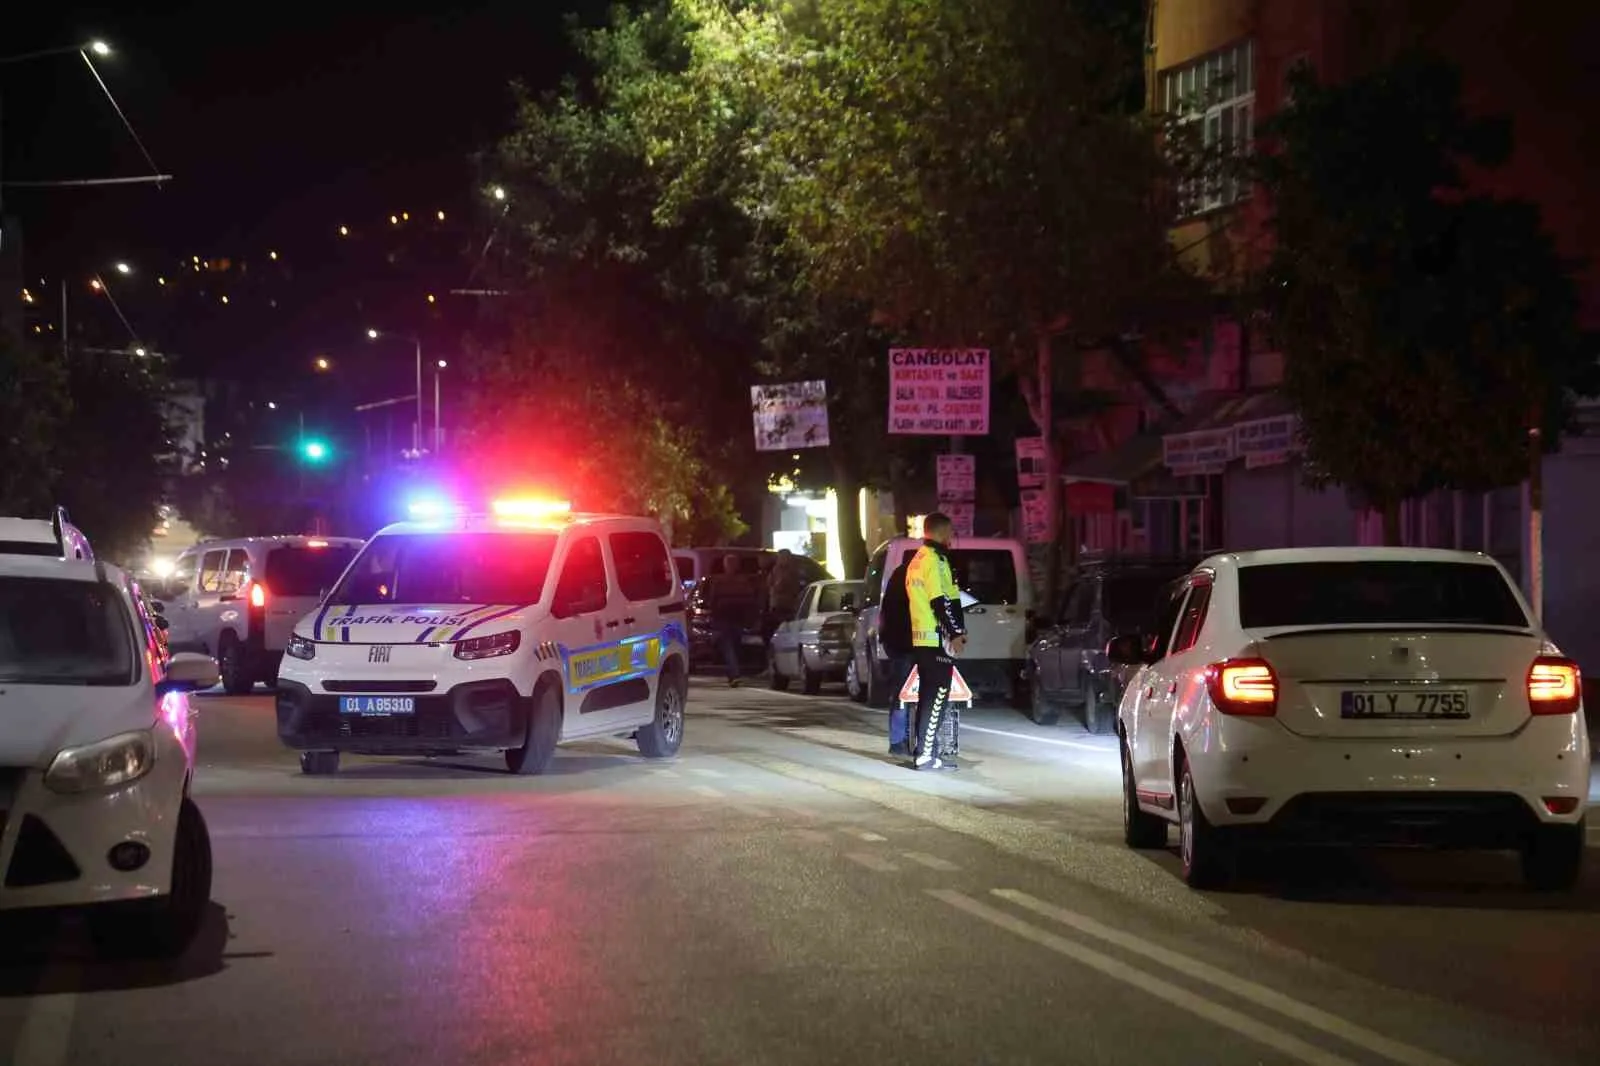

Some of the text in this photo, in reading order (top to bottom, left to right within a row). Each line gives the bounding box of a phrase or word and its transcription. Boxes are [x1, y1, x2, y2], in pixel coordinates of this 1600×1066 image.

[892, 351, 985, 366] CANBOLAT
[368, 645, 392, 663] FIAT
[346, 697, 360, 712] 01
[1354, 694, 1465, 713] 01 Y 7755
